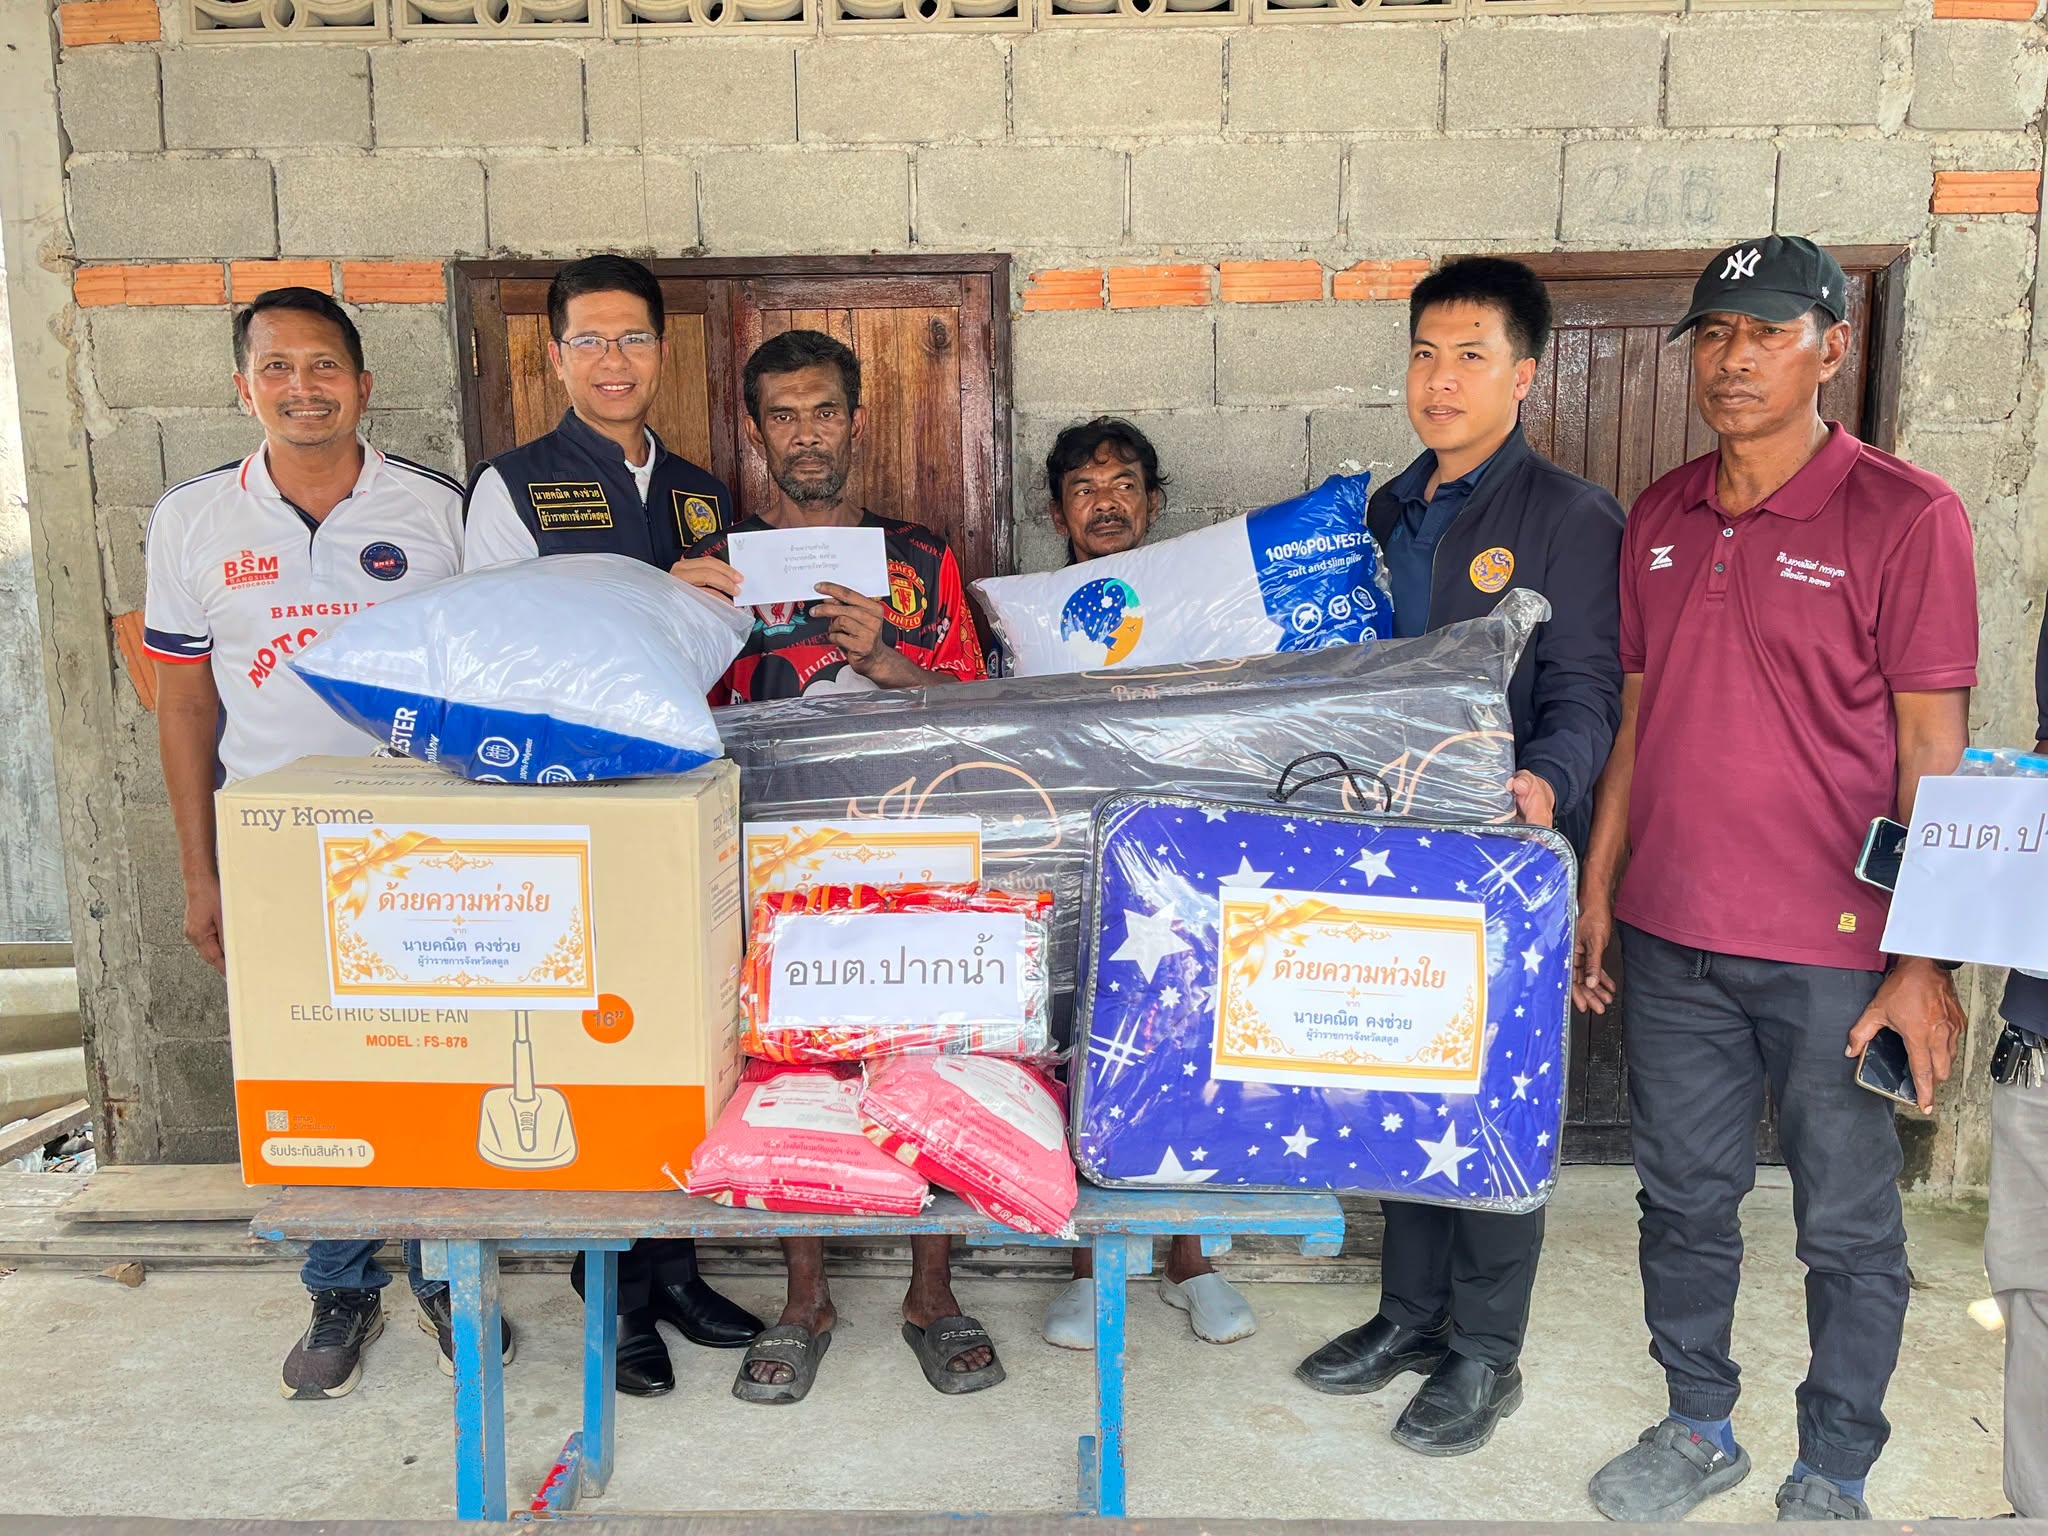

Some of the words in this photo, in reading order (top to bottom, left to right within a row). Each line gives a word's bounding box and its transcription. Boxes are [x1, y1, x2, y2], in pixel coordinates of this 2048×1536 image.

[224, 556, 278, 578] BSM
[1287, 565, 1307, 578] soft
[1308, 561, 1326, 573] and
[1328, 556, 1345, 569] slim
[241, 808, 286, 832] my
[291, 806, 374, 826] Home
[1921, 813, 2048, 852] อบต.ป
[378, 881, 550, 912] ด้วยความห่วงใย
[402, 937, 467, 952] นายคณิต
[474, 938, 520, 952] คงช่วย
[417, 955, 509, 968] ผู้ว่าราชการจังหวัดสตูล
[785, 933, 1005, 985] อบต.ปากน้ำ
[1272, 948, 1446, 989] ด้วยความห่วงใย
[380, 1008, 430, 1023] SLIDE
[437, 1008, 468, 1023] FAN
[1293, 1009, 1358, 1027] นายคณิต
[1366, 1013, 1412, 1030] คงช่วย
[366, 1035, 412, 1048] MODEL
[424, 1036, 468, 1049] FS-878
[1306, 1028, 1399, 1046] ผู้ว่าราชการจังหวัดสตูล
[270, 1144, 345, 1157] รับประกันสินค้า
[358, 1145, 366, 1157] ปี
